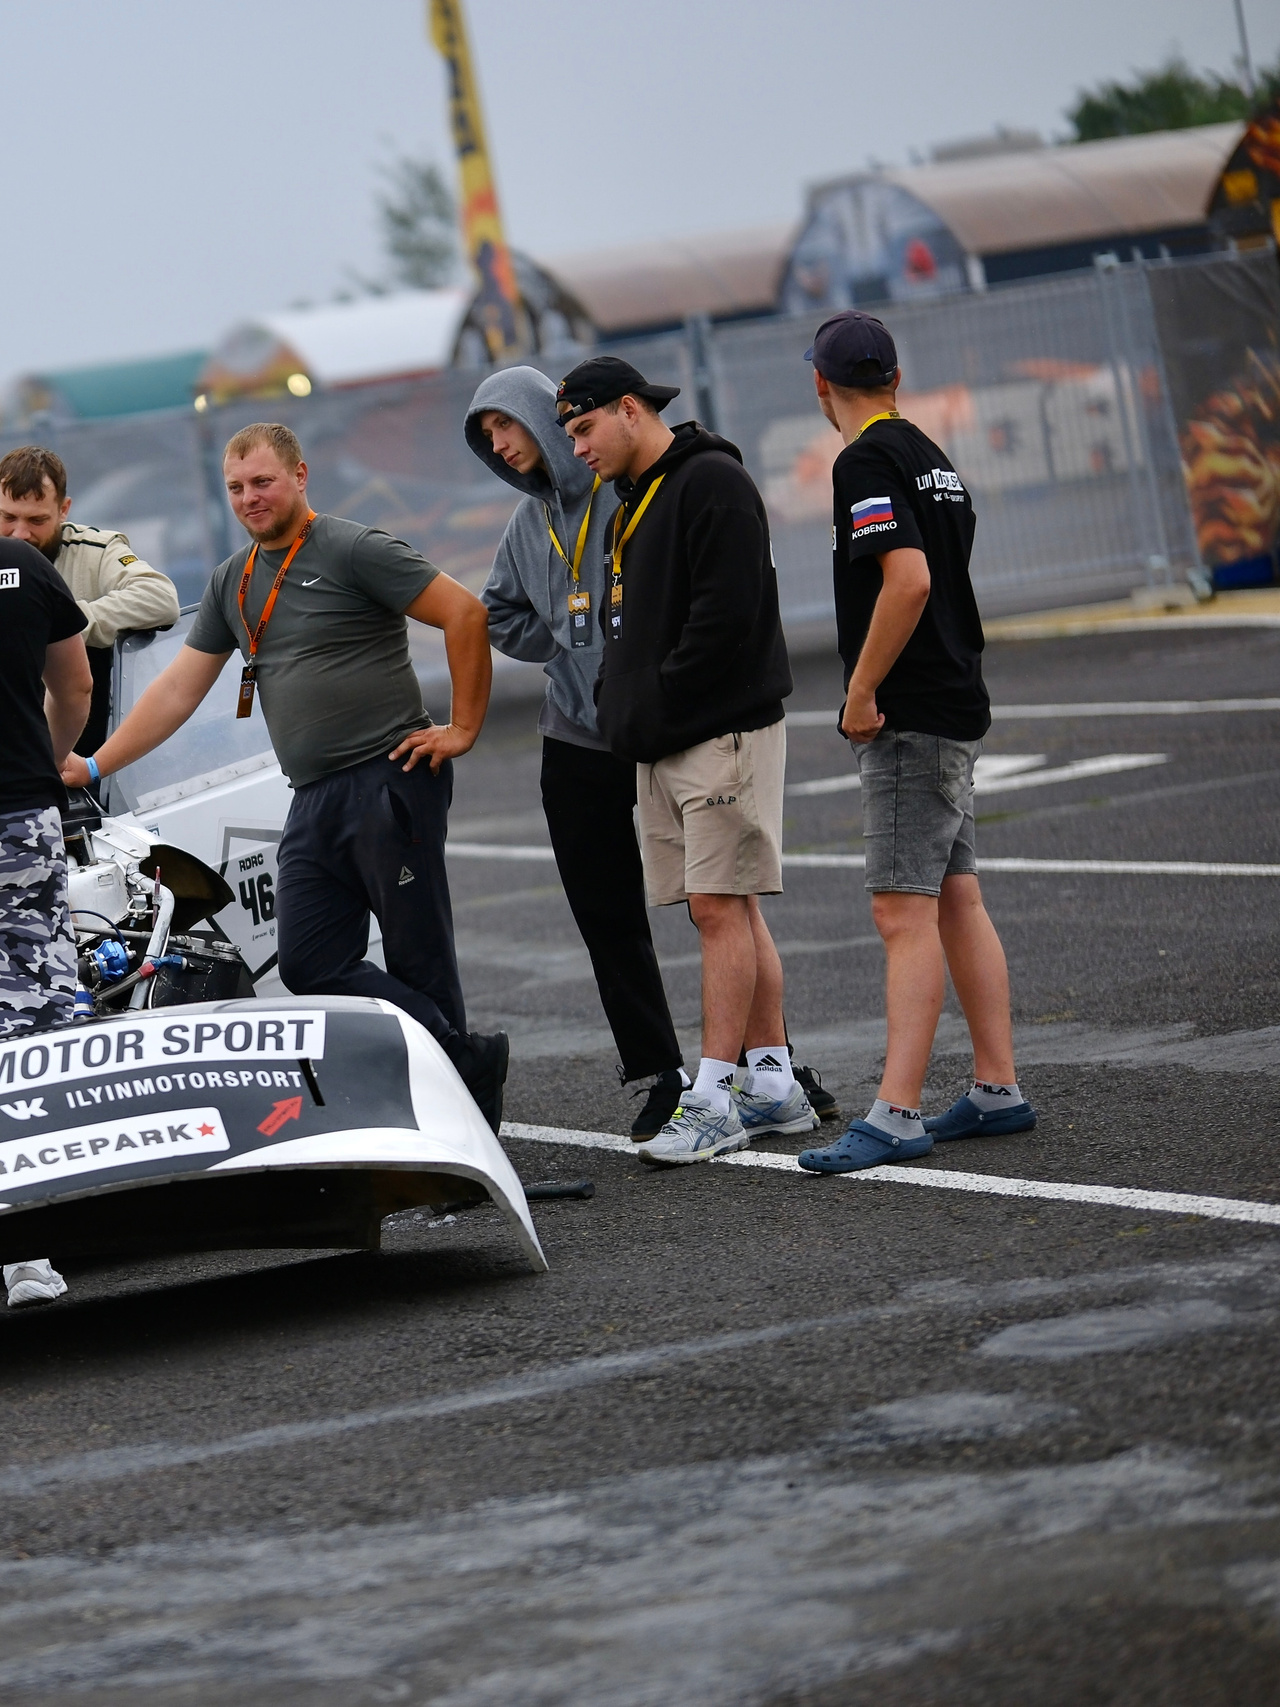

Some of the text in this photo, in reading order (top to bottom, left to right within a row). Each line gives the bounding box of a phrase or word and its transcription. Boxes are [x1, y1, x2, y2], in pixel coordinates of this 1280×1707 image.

[851, 521, 898, 540] KOBENKO
[240, 573, 251, 595] RDRC
[273, 567, 287, 591] RDRC
[706, 795, 737, 806] GAP
[238, 853, 264, 872] RDRC
[238, 872, 275, 926] 46
[161, 1018, 314, 1056] SPORT
[66, 1070, 302, 1109] ILYINMOTORSPORT
[975, 1081, 1012, 1096] FILA
[888, 1106, 921, 1121] FILA
